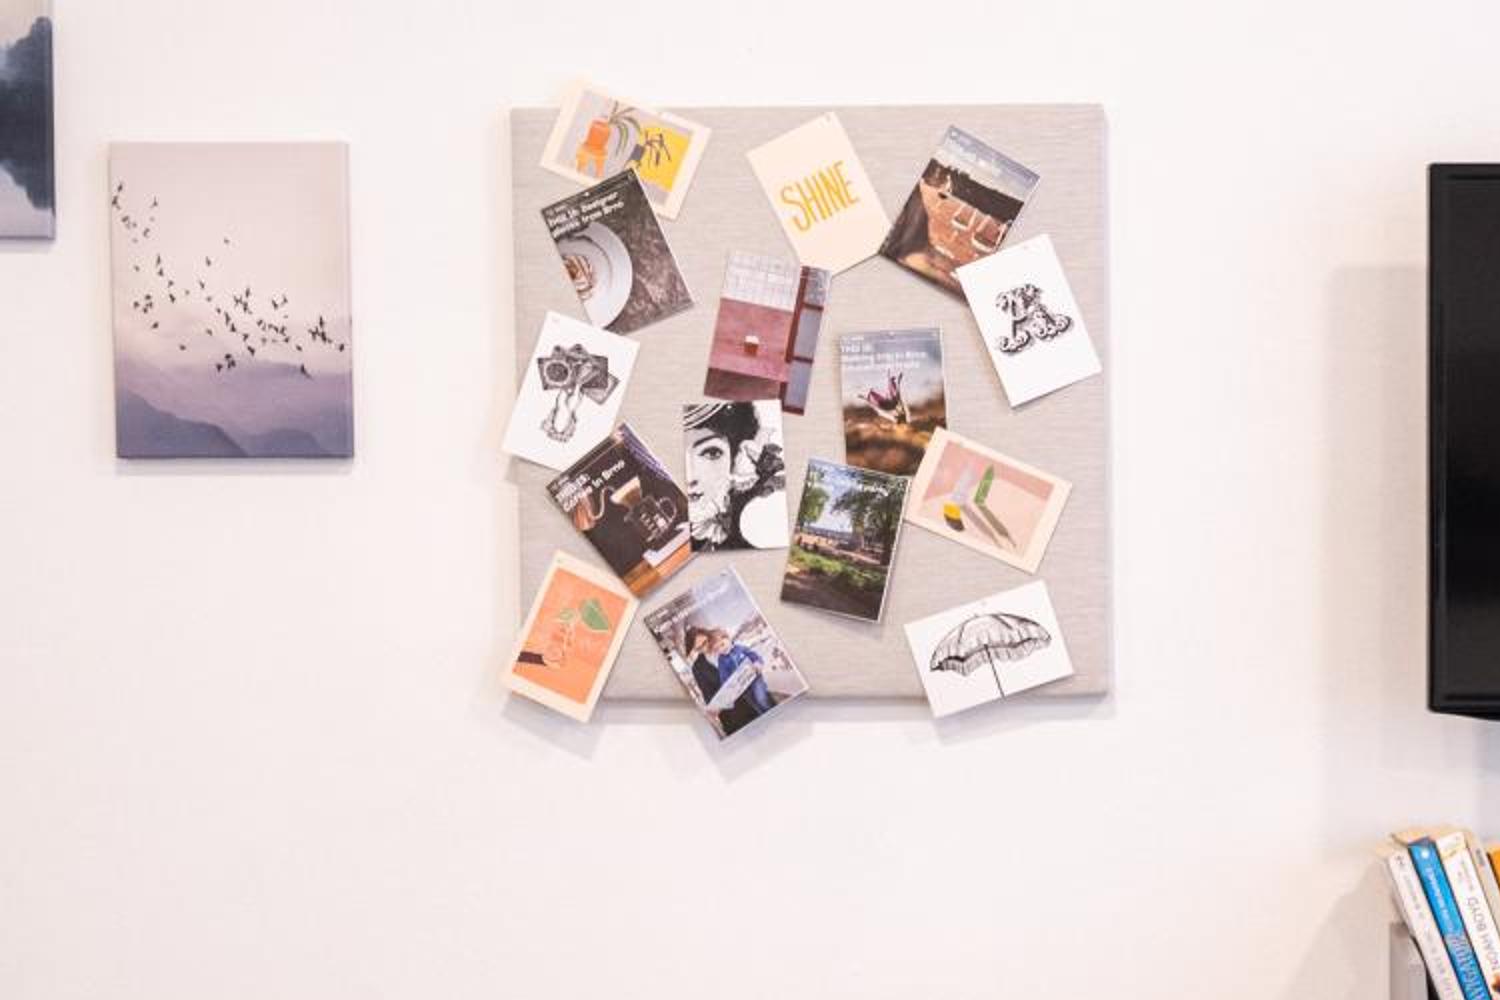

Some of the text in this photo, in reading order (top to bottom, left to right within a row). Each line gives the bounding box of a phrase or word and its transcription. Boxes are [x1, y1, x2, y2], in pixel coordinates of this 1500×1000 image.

[780, 160, 860, 231] SHINE
[1465, 896, 1500, 971] NOAH BOYD
